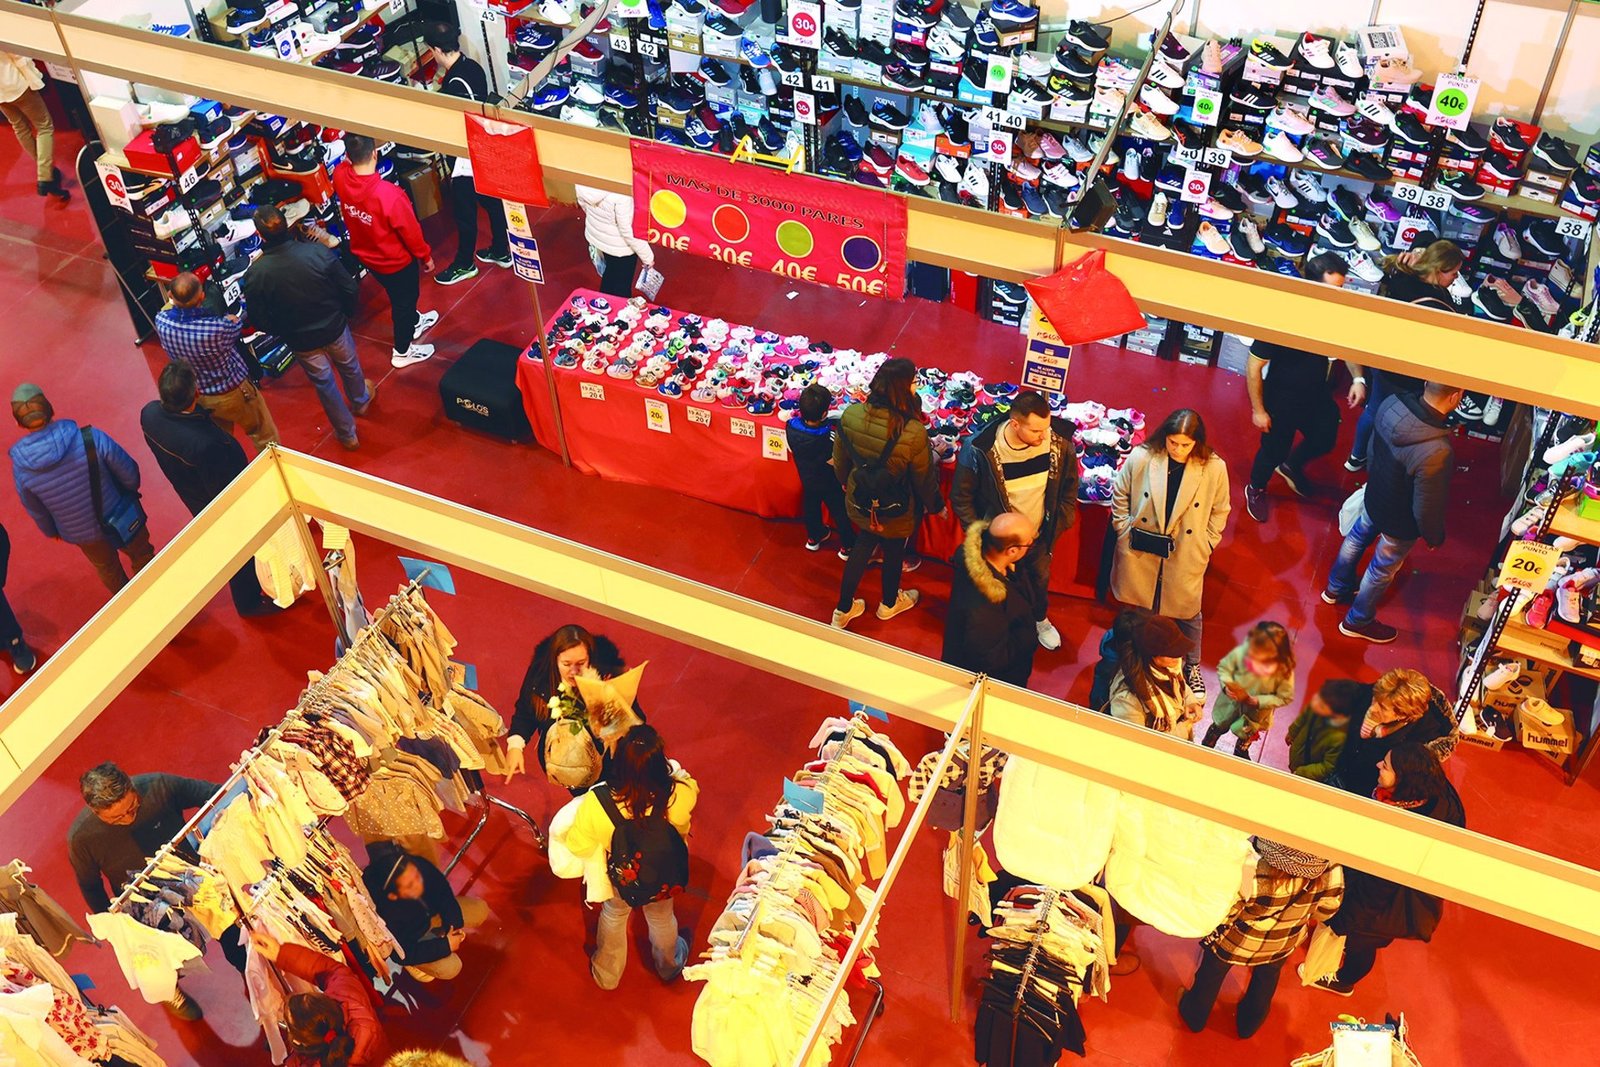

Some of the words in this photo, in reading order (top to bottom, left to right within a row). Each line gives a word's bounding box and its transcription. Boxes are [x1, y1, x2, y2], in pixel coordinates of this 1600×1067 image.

[482, 11, 495, 21] 43
[795, 18, 815, 31] 30€
[614, 39, 627, 51] 43
[641, 43, 654, 56] 42
[785, 74, 800, 86] 42
[816, 79, 830, 91] 41
[1198, 102, 1211, 111] 40€
[1440, 95, 1465, 110] 40€
[986, 110, 1001, 122] 41
[1006, 115, 1022, 127] 40
[992, 143, 1006, 152] 30€
[1180, 150, 1198, 160] 40
[1208, 151, 1226, 165] 39
[184, 173, 196, 189] 46
[1189, 183, 1204, 192] 30€
[666, 174, 711, 193] MAS
[717, 186, 742, 202] DE
[747, 193, 796, 213] 3000
[801, 206, 865, 230] PARES
[1397, 187, 1417, 201] 39
[1426, 195, 1445, 209] 38
[344, 204, 373, 222] POLOS
[511, 214, 524, 224] 20€
[1403, 230, 1416, 239] 30
[1561, 222, 1582, 236] 38
[708, 243, 753, 269] 30€
[771, 258, 818, 283] 40€
[836, 272, 884, 296] 50€
[228, 286, 239, 302] 45
[456, 397, 489, 414] POLOS
[650, 411, 663, 420] 20€
[769, 440, 782, 449] 20€
[1515, 540, 1559, 552] ZAPATILLAS
[1523, 545, 1548, 555] PUNTO
[1512, 558, 1542, 575] 20€
[1493, 699, 1517, 711] hum
[1528, 732, 1568, 747] hummel
